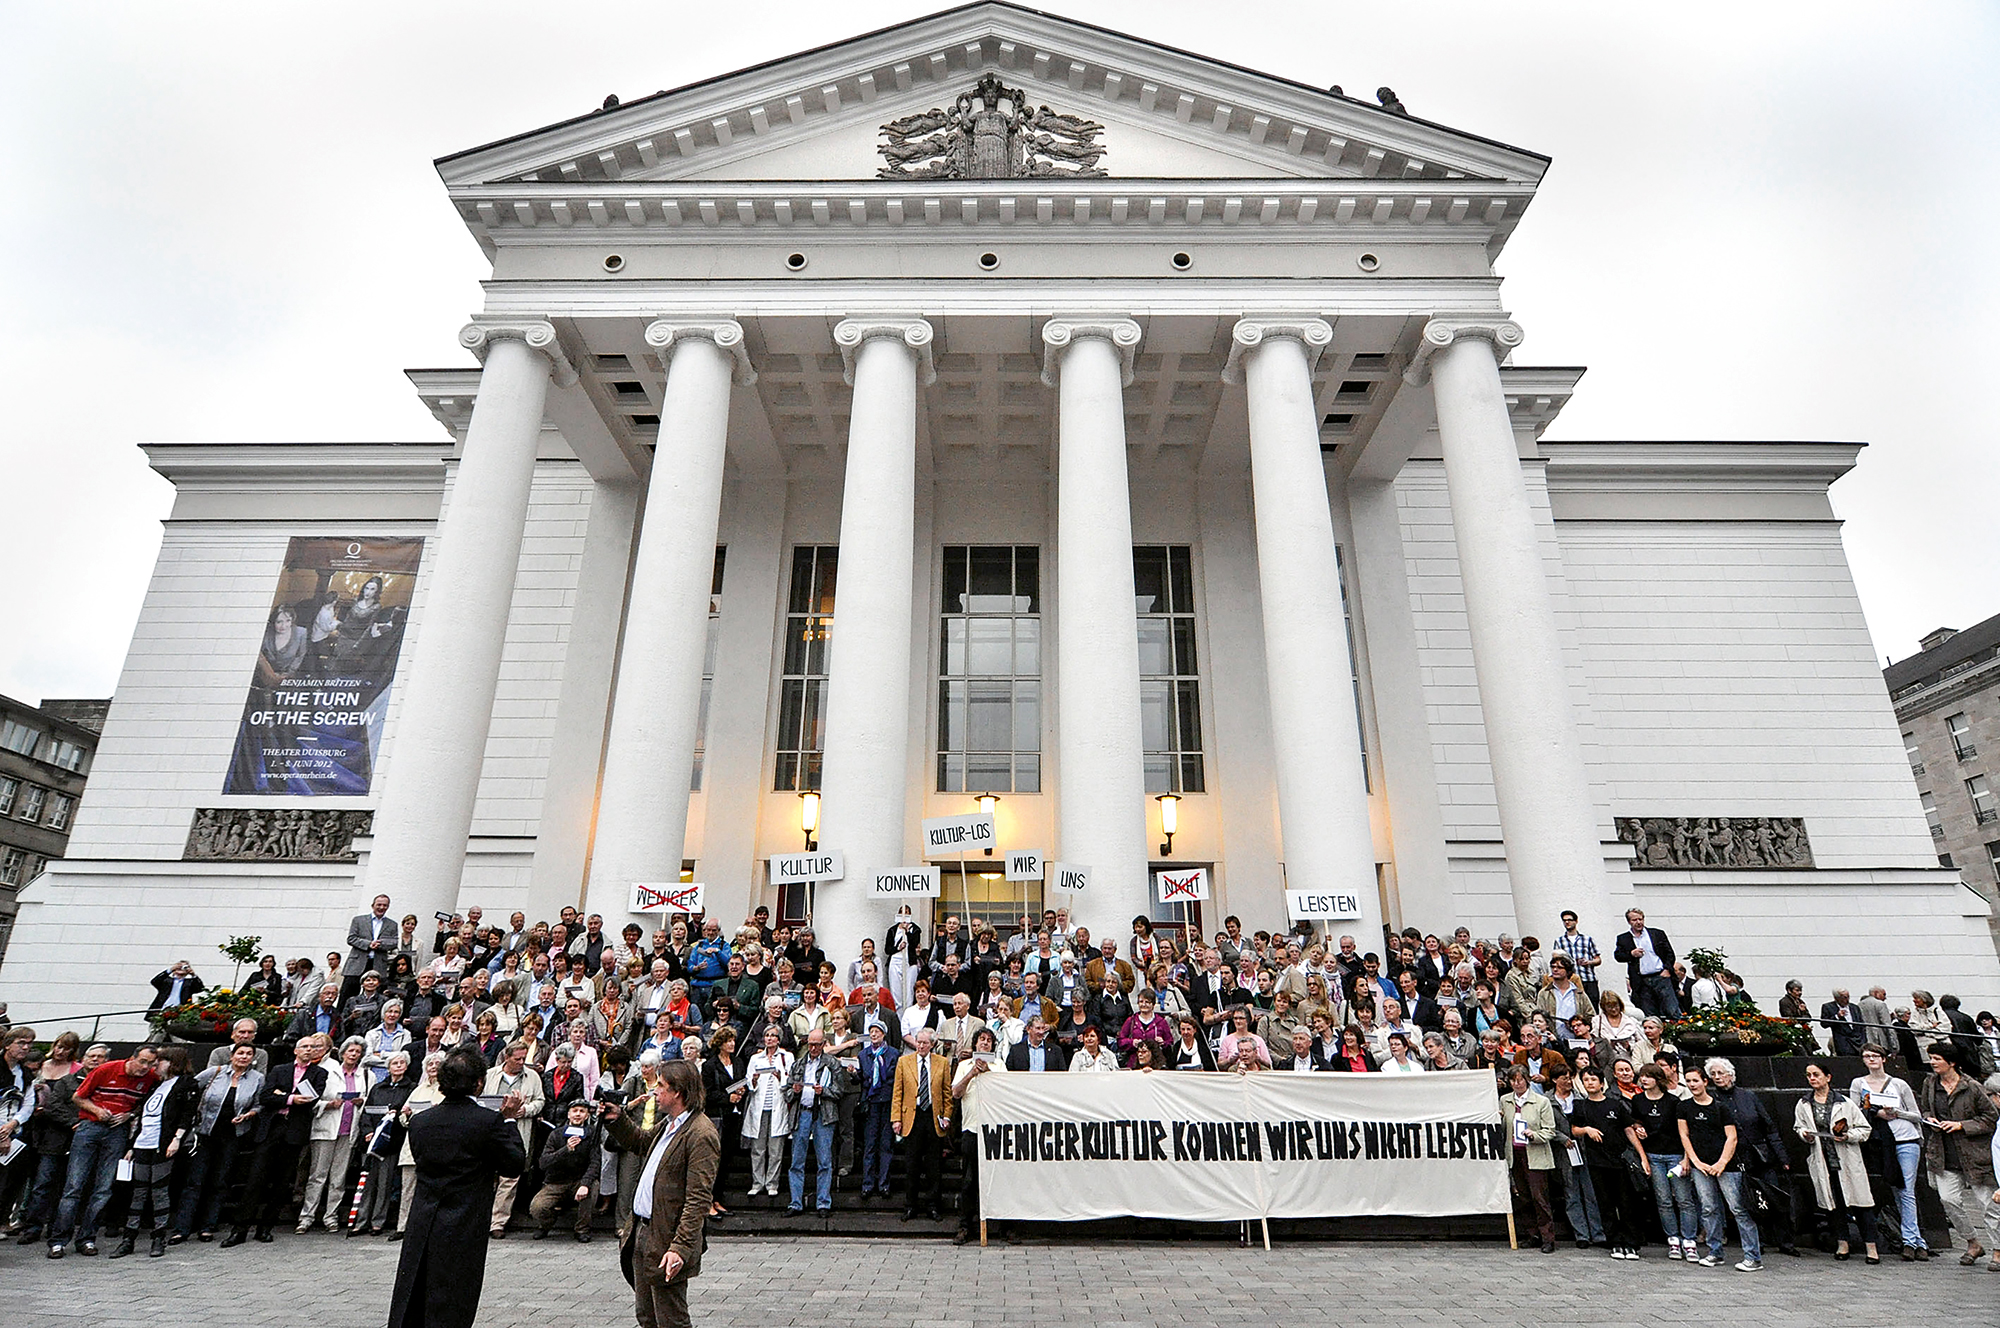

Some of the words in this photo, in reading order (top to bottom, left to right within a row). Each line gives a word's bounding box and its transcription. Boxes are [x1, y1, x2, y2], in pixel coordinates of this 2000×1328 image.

[280, 679, 324, 687] BENJAMIN
[275, 691, 309, 706] THE
[312, 692, 360, 706] TURN
[250, 711, 275, 725] OF
[276, 711, 311, 725] THE
[312, 712, 377, 726] SCREW
[262, 748, 300, 756] THEATER
[301, 749, 347, 757] DUISBURG
[313, 760, 333, 768] 2012
[260, 771, 338, 781] www.operamrhein.de
[929, 823, 991, 846] KULTUR-LOS
[780, 857, 833, 876] KULTUR
[1013, 856, 1037, 873] WIR
[1060, 871, 1086, 889] UNS
[636, 889, 698, 906] WENIGER
[1298, 895, 1357, 913] LEISTEN
[1171, 1120, 1262, 1161] KÖNNEN
[1264, 1121, 1314, 1161] WIR
[1314, 1121, 1362, 1160] UNS
[1362, 1121, 1422, 1160] NICHT
[1424, 1122, 1506, 1160] LEISTEN
